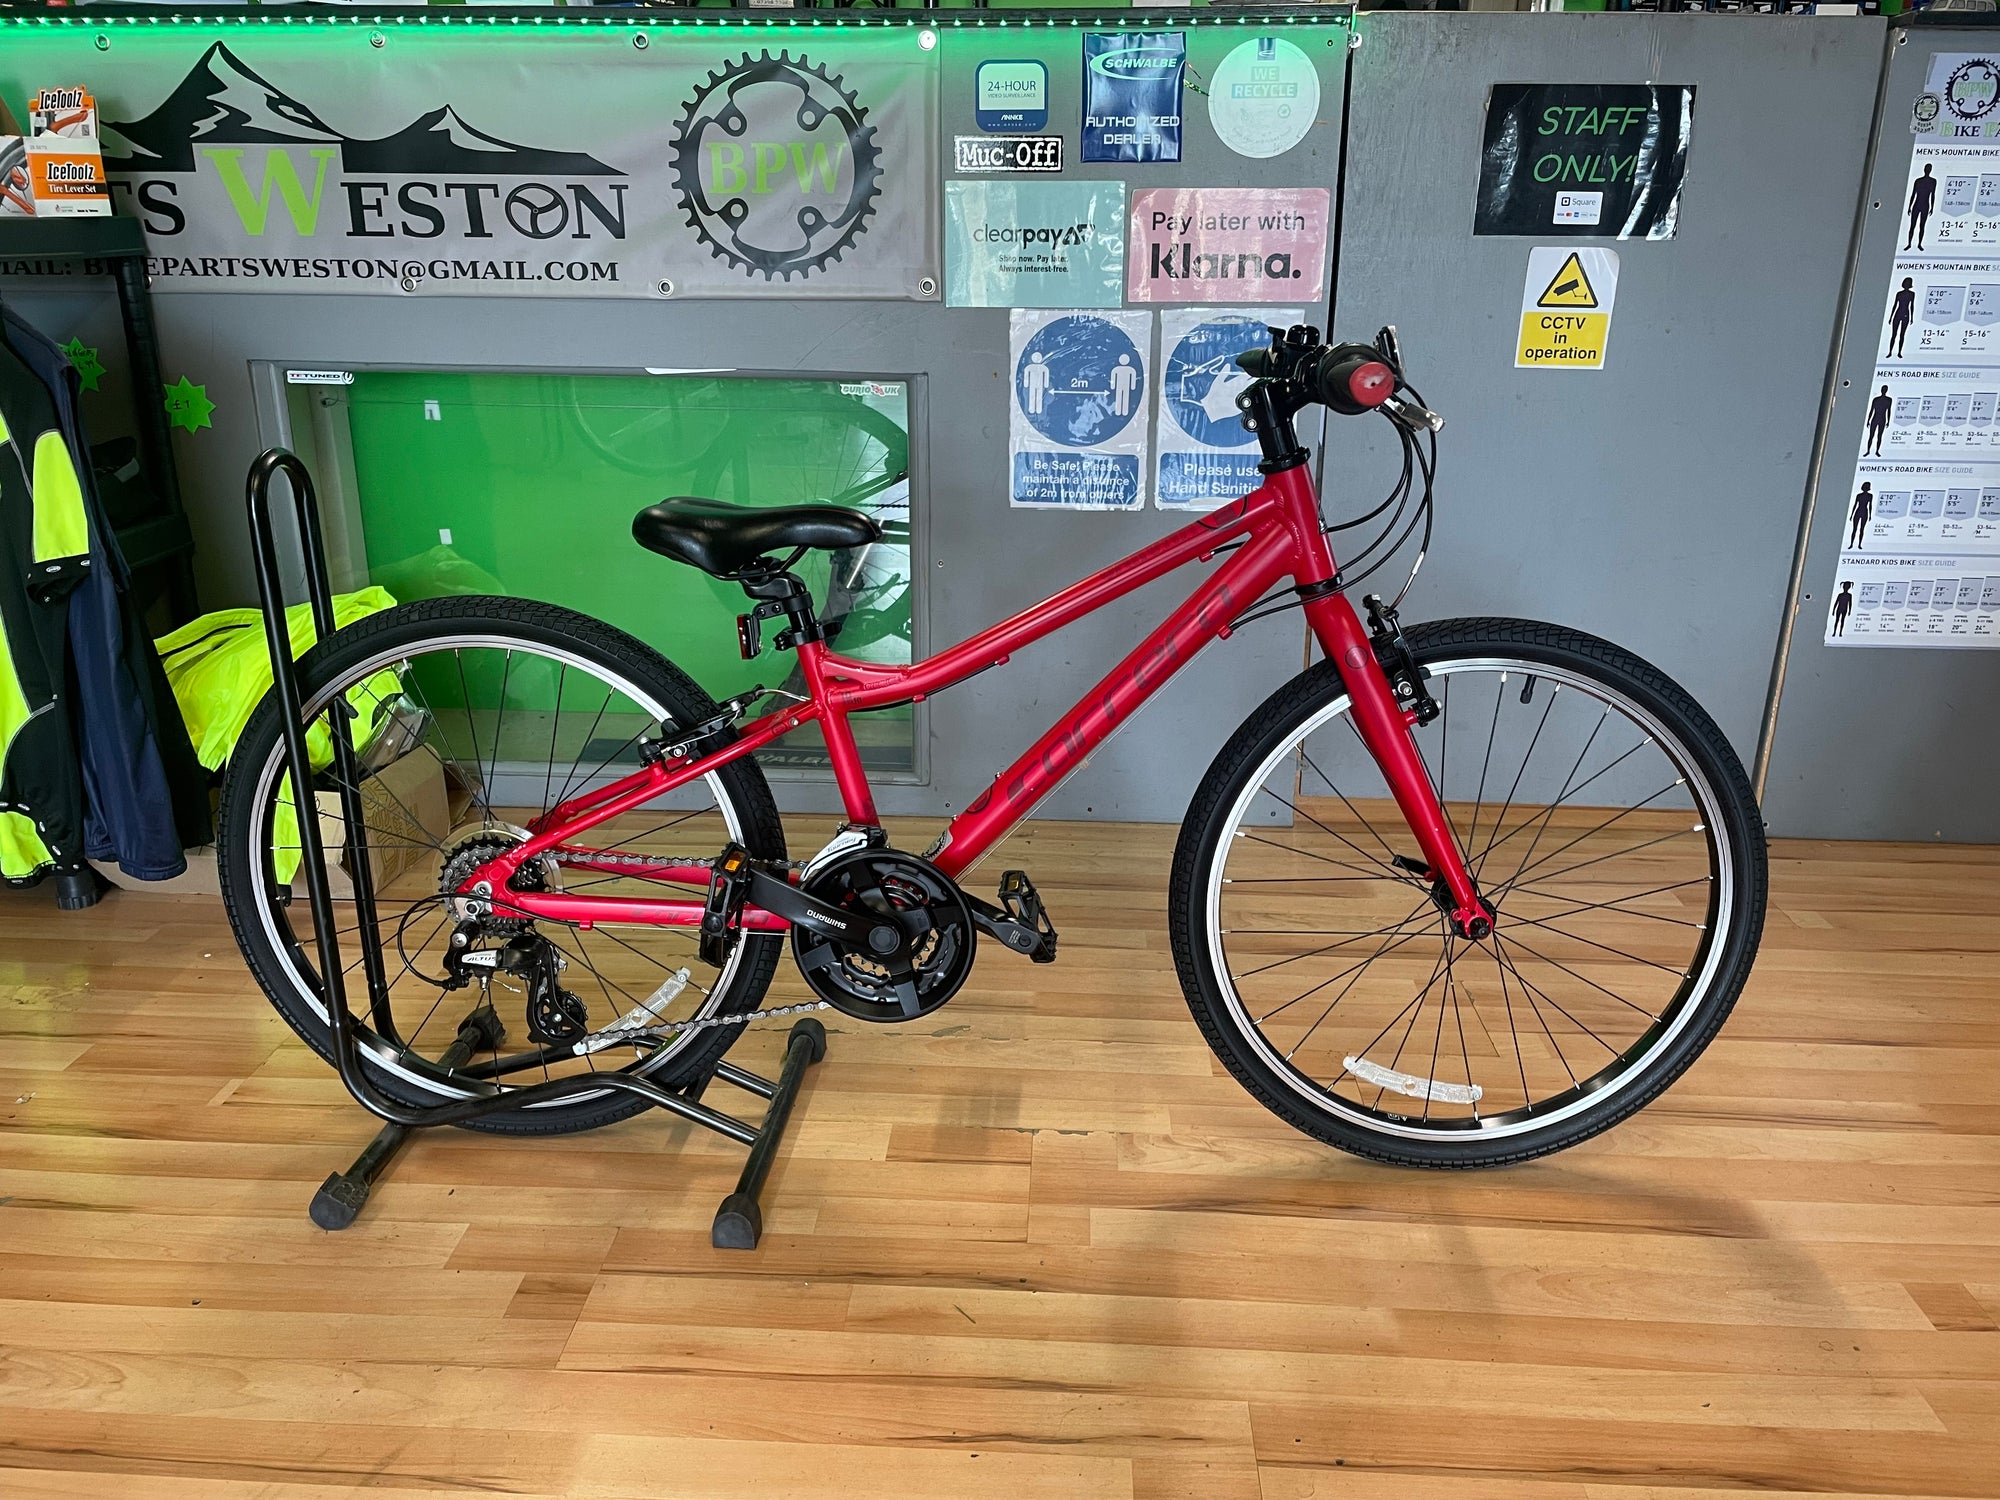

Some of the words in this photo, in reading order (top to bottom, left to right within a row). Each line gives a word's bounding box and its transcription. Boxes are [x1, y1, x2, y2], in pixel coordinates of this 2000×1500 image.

[1105, 58, 1177, 68] SCHWALBE
[1253, 67, 1278, 80] WE
[987, 80, 1037, 92] 24-HOUR
[1234, 84, 1296, 97] RECYCLE
[1954, 81, 1994, 98] BPW
[40, 89, 82, 110] IceToolz
[1537, 106, 1647, 136] STAFF
[1940, 121, 1981, 137] BIKE
[1103, 133, 1162, 145] DEALER
[962, 142, 1057, 166] Muc-Off
[47, 163, 94, 181] IceToolz
[705, 142, 848, 195] BPW
[1533, 154, 1639, 184] ONLY!
[48, 184, 66, 193] Tire
[64, 184, 84, 194] Lever
[84, 184, 97, 193] Set
[203, 149, 629, 240] WESTON
[1571, 198, 1597, 207] Square
[1152, 211, 1193, 236] Pay
[1200, 210, 1250, 231] later
[1257, 210, 1305, 231] with
[973, 223, 1063, 250] clearpay
[999, 254, 1017, 264] Shop
[1036, 254, 1049, 264] Pay
[1150, 243, 1302, 280] Klarna.
[83, 257, 620, 284] BIEPARTSWESTON@GMAIL.COM
[999, 265, 1023, 274] Always
[1540, 316, 1586, 330] CCTV
[1553, 332, 1568, 344] in
[1525, 347, 1597, 361] operation
[842, 385, 871, 394] CURIO
[884, 385, 898, 394] UK
[1070, 378, 1089, 389] 2m
[1033, 460, 1048, 470] Be
[1051, 460, 1080, 472] Safe!
[1082, 461, 1120, 472] Please
[1183, 463, 1232, 476] Please
[1236, 467, 1260, 477] use
[1022, 475, 1070, 485] maintain
[1072, 477, 1080, 485] a
[1026, 488, 1038, 498] of
[1040, 488, 1058, 498] 2m
[1060, 489, 1086, 499] from
[1089, 490, 1125, 500] others
[1168, 481, 1207, 494] Hand
[806, 909, 847, 930] SHIMANO
